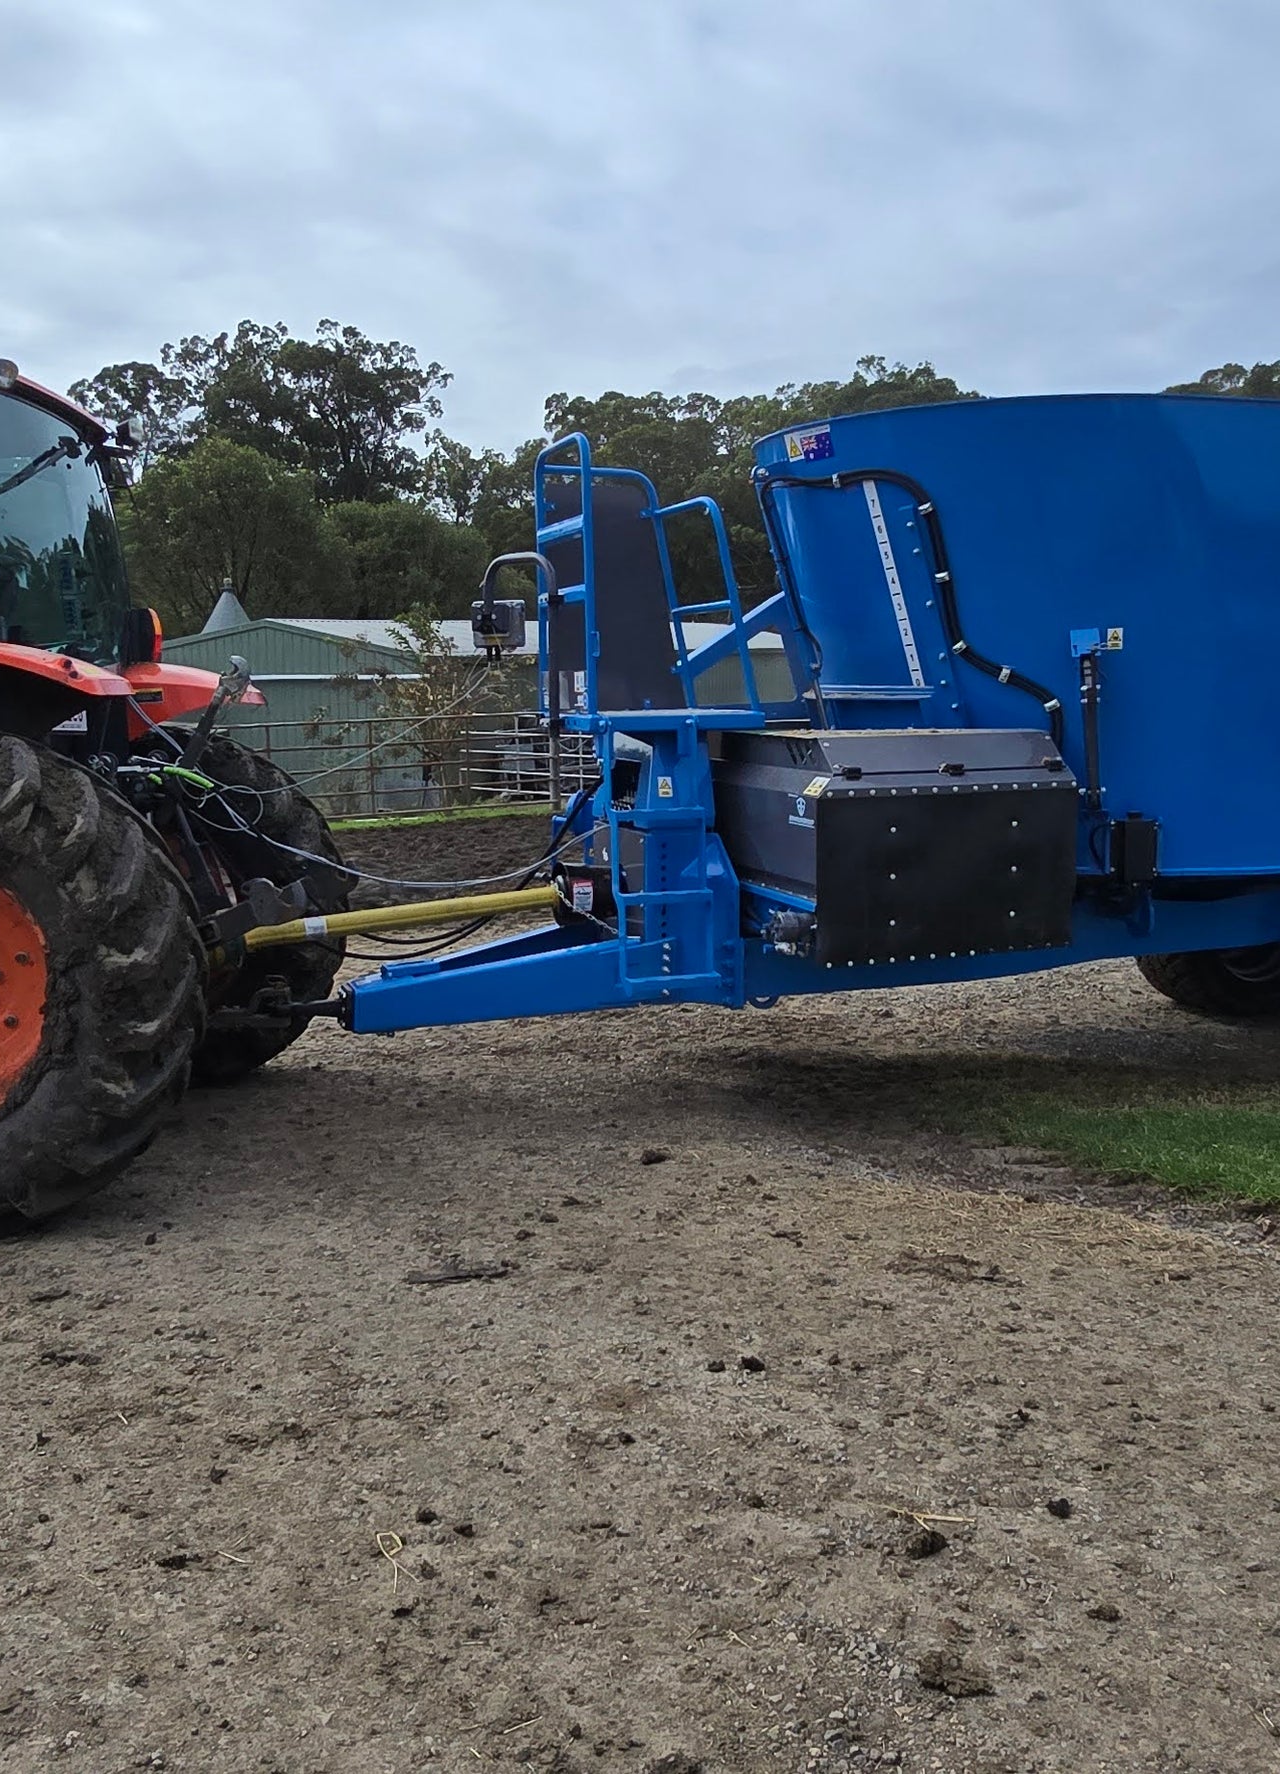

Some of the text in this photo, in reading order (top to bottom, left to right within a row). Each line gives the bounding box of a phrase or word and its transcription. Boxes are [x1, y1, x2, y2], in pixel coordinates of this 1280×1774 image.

[870, 499, 875, 508] 7
[877, 525, 883, 534] 6
[884, 551, 890, 560] 5
[891, 577, 896, 585] 4
[897, 602, 902, 611] 3
[903, 628, 908, 637] 2
[910, 654, 915, 662] 1
[915, 678, 921, 687] 0
